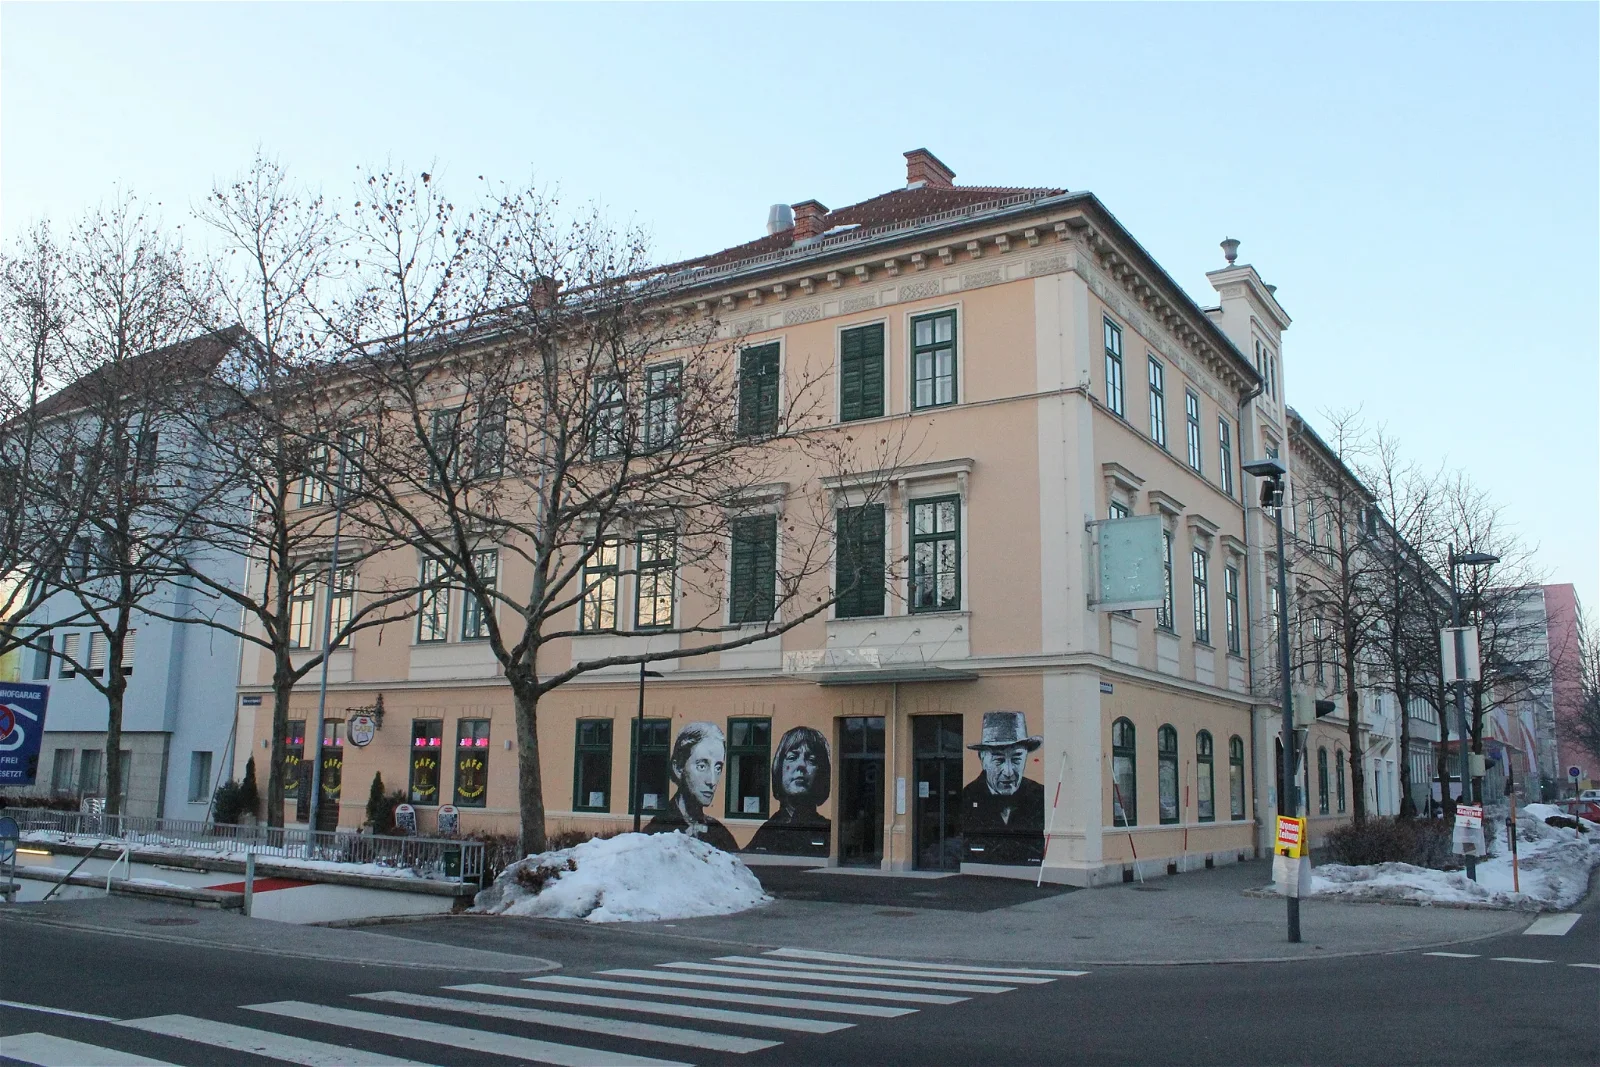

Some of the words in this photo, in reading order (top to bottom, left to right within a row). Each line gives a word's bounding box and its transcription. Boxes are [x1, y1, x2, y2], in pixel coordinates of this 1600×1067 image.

[285, 755, 299, 765] AFE
[414, 758, 436, 769] CAFE
[460, 759, 483, 770] CAFE
